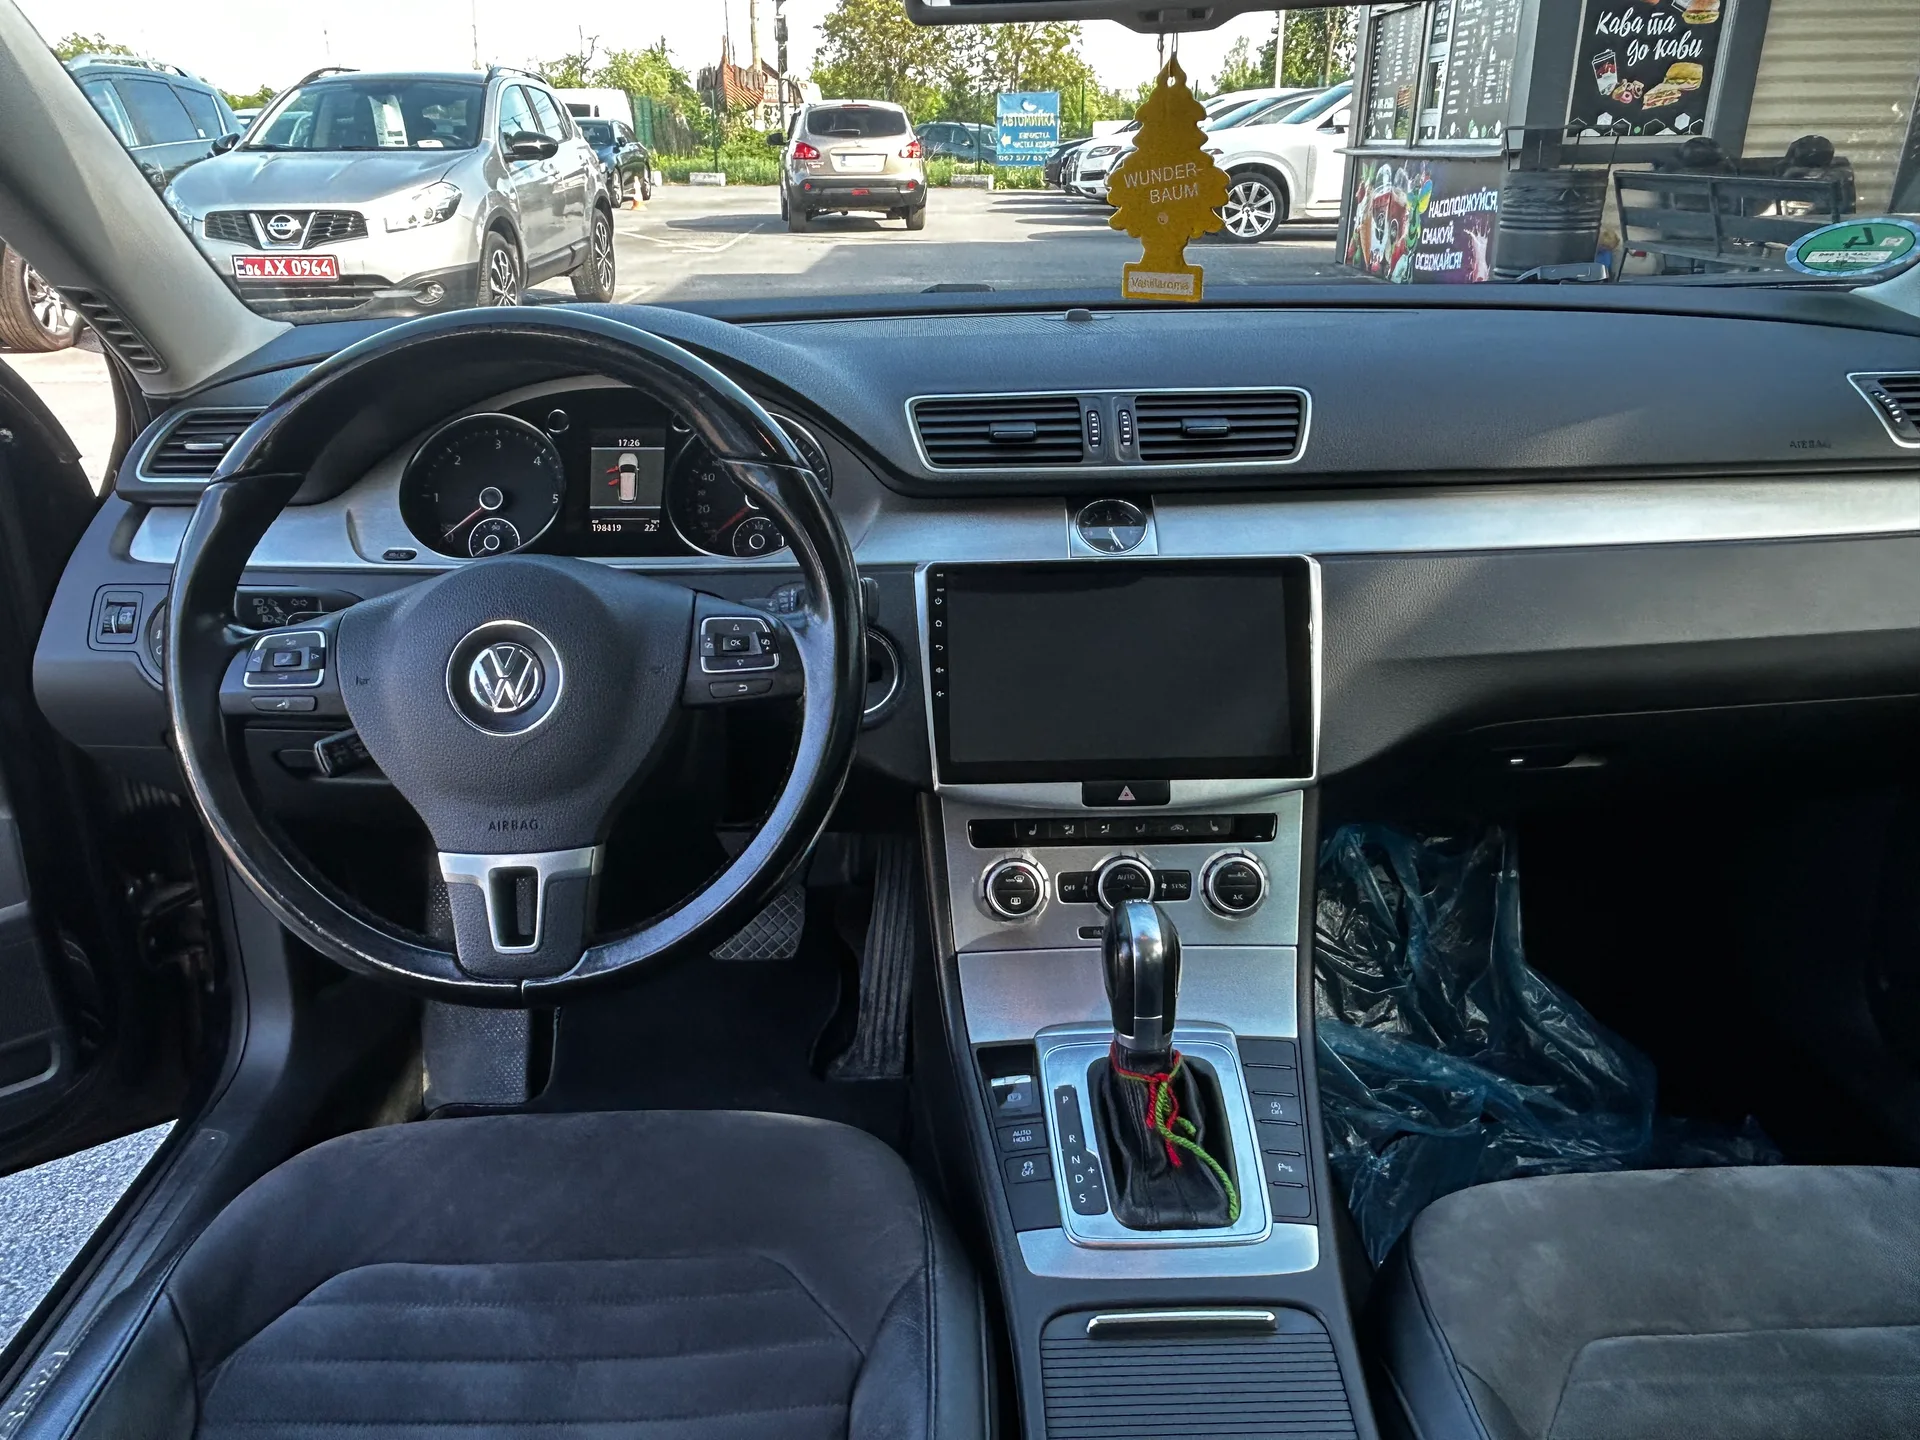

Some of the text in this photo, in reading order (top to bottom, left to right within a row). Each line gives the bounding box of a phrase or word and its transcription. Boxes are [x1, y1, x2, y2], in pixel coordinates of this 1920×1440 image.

[1595, 7, 1677, 37] Кава та
[1627, 30, 1704, 67] до кави
[1124, 162, 1204, 188] WUNDER-
[1150, 182, 1199, 204] BAUM
[1429, 186, 1498, 218] НАСОЛОДЖУЙСЯ,
[264, 260, 289, 275] AX
[291, 260, 331, 275] 0964
[618, 439, 640, 447] 17:26
[454, 455, 461, 466] 2
[533, 456, 542, 466] 4
[701, 473, 716, 482] 40
[552, 494, 559, 503] 5
[488, 819, 539, 832] AIRBAG
[1062, 1096, 1069, 1104] P
[1012, 1129, 1032, 1137] AUTO
[1069, 1135, 1076, 1143] R
[1071, 1155, 1081, 1164] N
[1075, 1175, 1084, 1183] D
[1079, 1193, 1086, 1203] S
